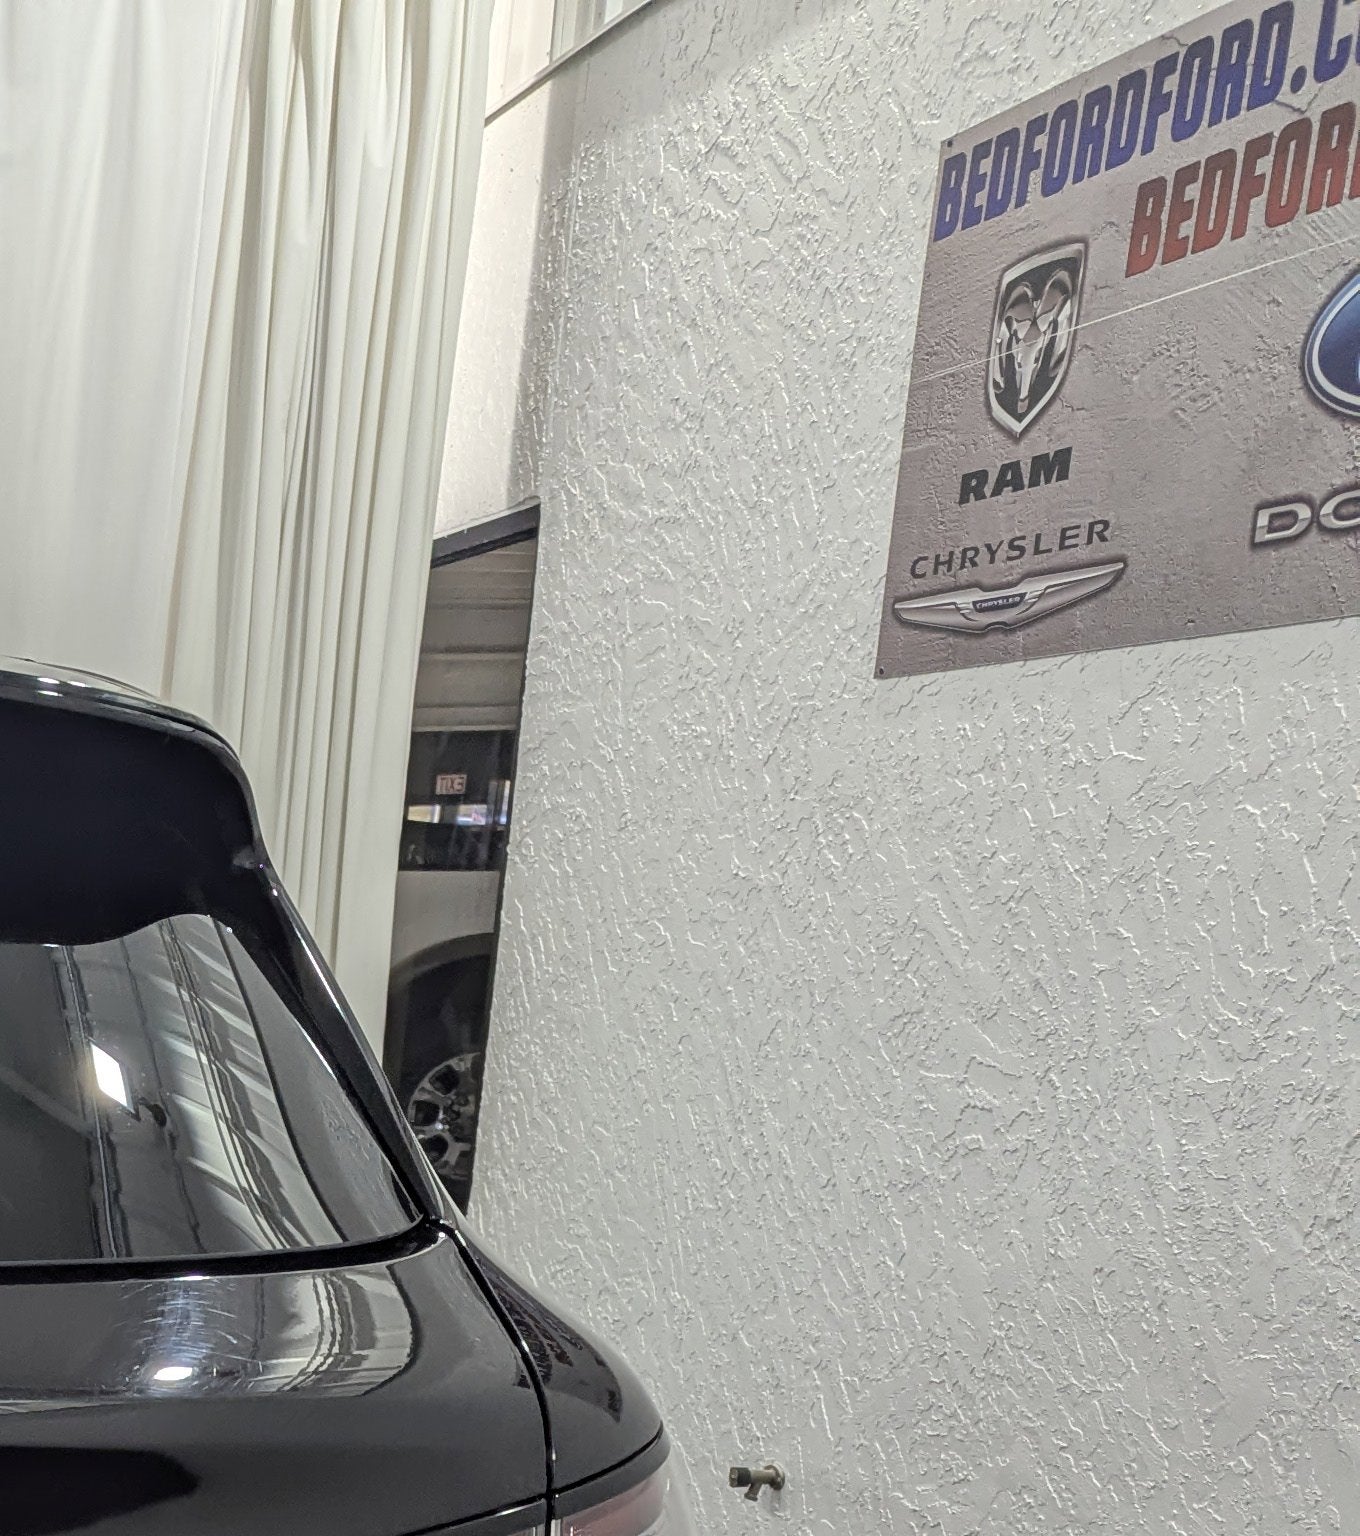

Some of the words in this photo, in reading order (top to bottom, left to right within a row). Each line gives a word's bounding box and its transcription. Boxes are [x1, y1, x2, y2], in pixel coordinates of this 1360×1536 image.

[932, 0, 1360, 243] BEDFORDFORD.C
[958, 447, 1073, 506] RAM
[909, 519, 1111, 580] CHRYSLER
